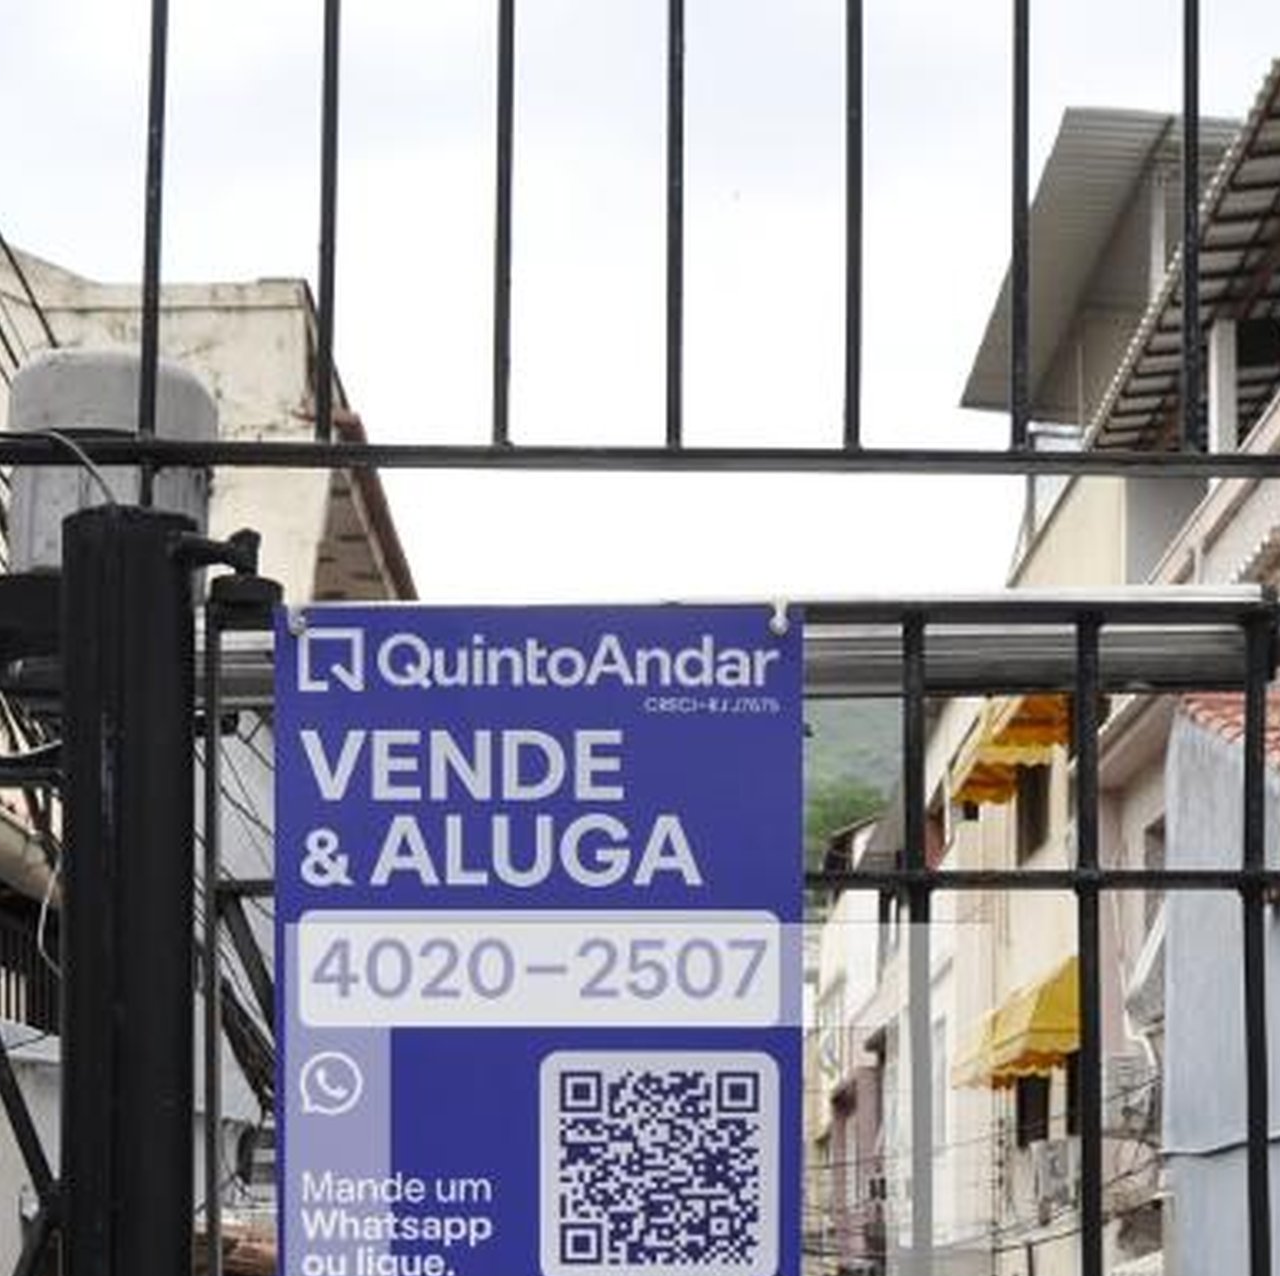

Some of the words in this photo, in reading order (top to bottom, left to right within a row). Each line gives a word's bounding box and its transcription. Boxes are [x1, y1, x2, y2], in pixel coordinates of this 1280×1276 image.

[376, 632, 780, 689] QuintoAndar
[299, 729, 625, 801] VENDE
[299, 828, 355, 887] &
[369, 812, 704, 888] ALUGA
[311, 938, 769, 1000] 4020-2507
[301, 1172, 425, 1203] Mande
[435, 1179, 492, 1203] um
[301, 1209, 493, 1246] Whatsapp
